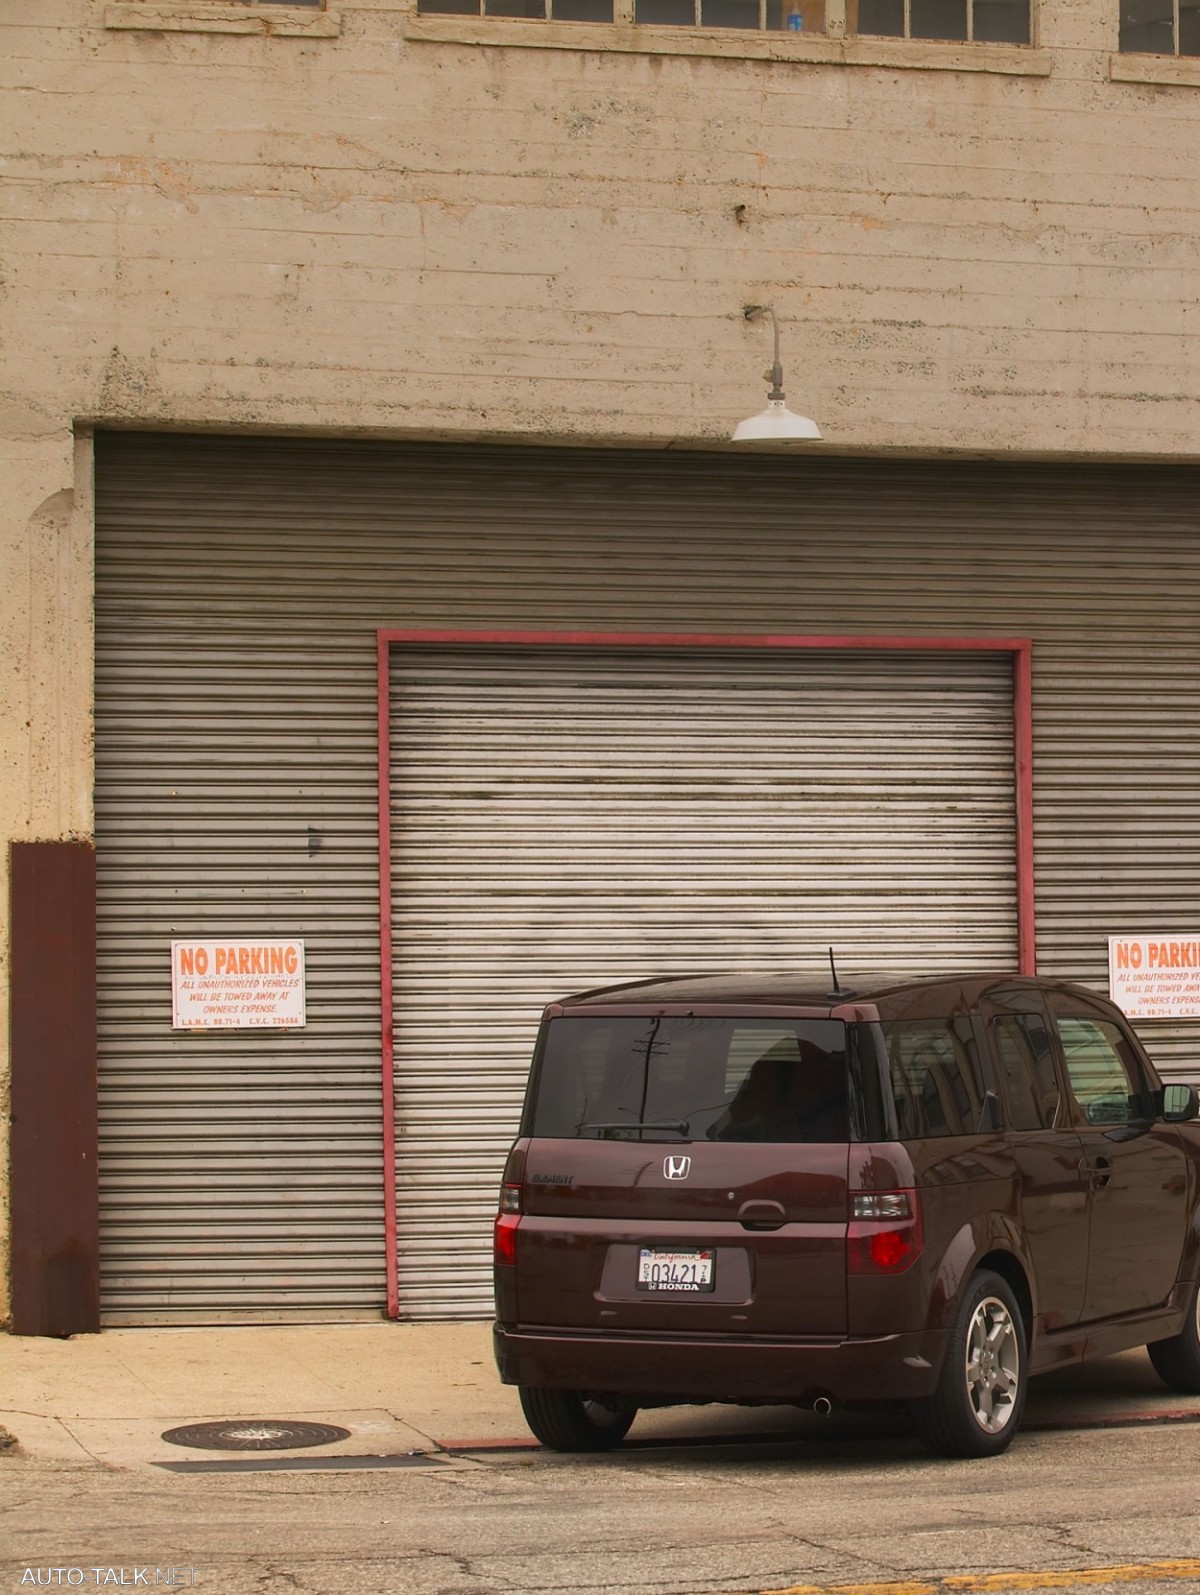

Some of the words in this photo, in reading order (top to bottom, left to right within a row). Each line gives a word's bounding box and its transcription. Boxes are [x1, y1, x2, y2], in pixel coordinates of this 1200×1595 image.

[180, 948, 208, 975] NO
[215, 946, 298, 975] PARKING
[1117, 943, 1142, 969] NO
[1117, 974, 1130, 982] ALL
[1133, 973, 1188, 982] UNAUTHORIZED
[181, 981, 194, 990] ALL
[198, 980, 259, 989] UNAUTHORIZED
[262, 979, 299, 988] VEHICLES
[1125, 985, 1141, 993] WILL
[1144, 985, 1153, 993] BE
[1157, 984, 1182, 992] TOWED
[190, 993, 207, 1001] WILL
[210, 993, 221, 1001] BE
[225, 992, 252, 1001] TOWED
[254, 992, 276, 1001] AWAY
[280, 991, 289, 1000] AT
[1138, 996, 1170, 1005] OWNERS
[203, 1005, 238, 1014] OWNERS
[241, 1004, 278, 1013] EXPENSE.
[654, 1252, 700, 1263] California
[652, 1264, 697, 1282] 03421
